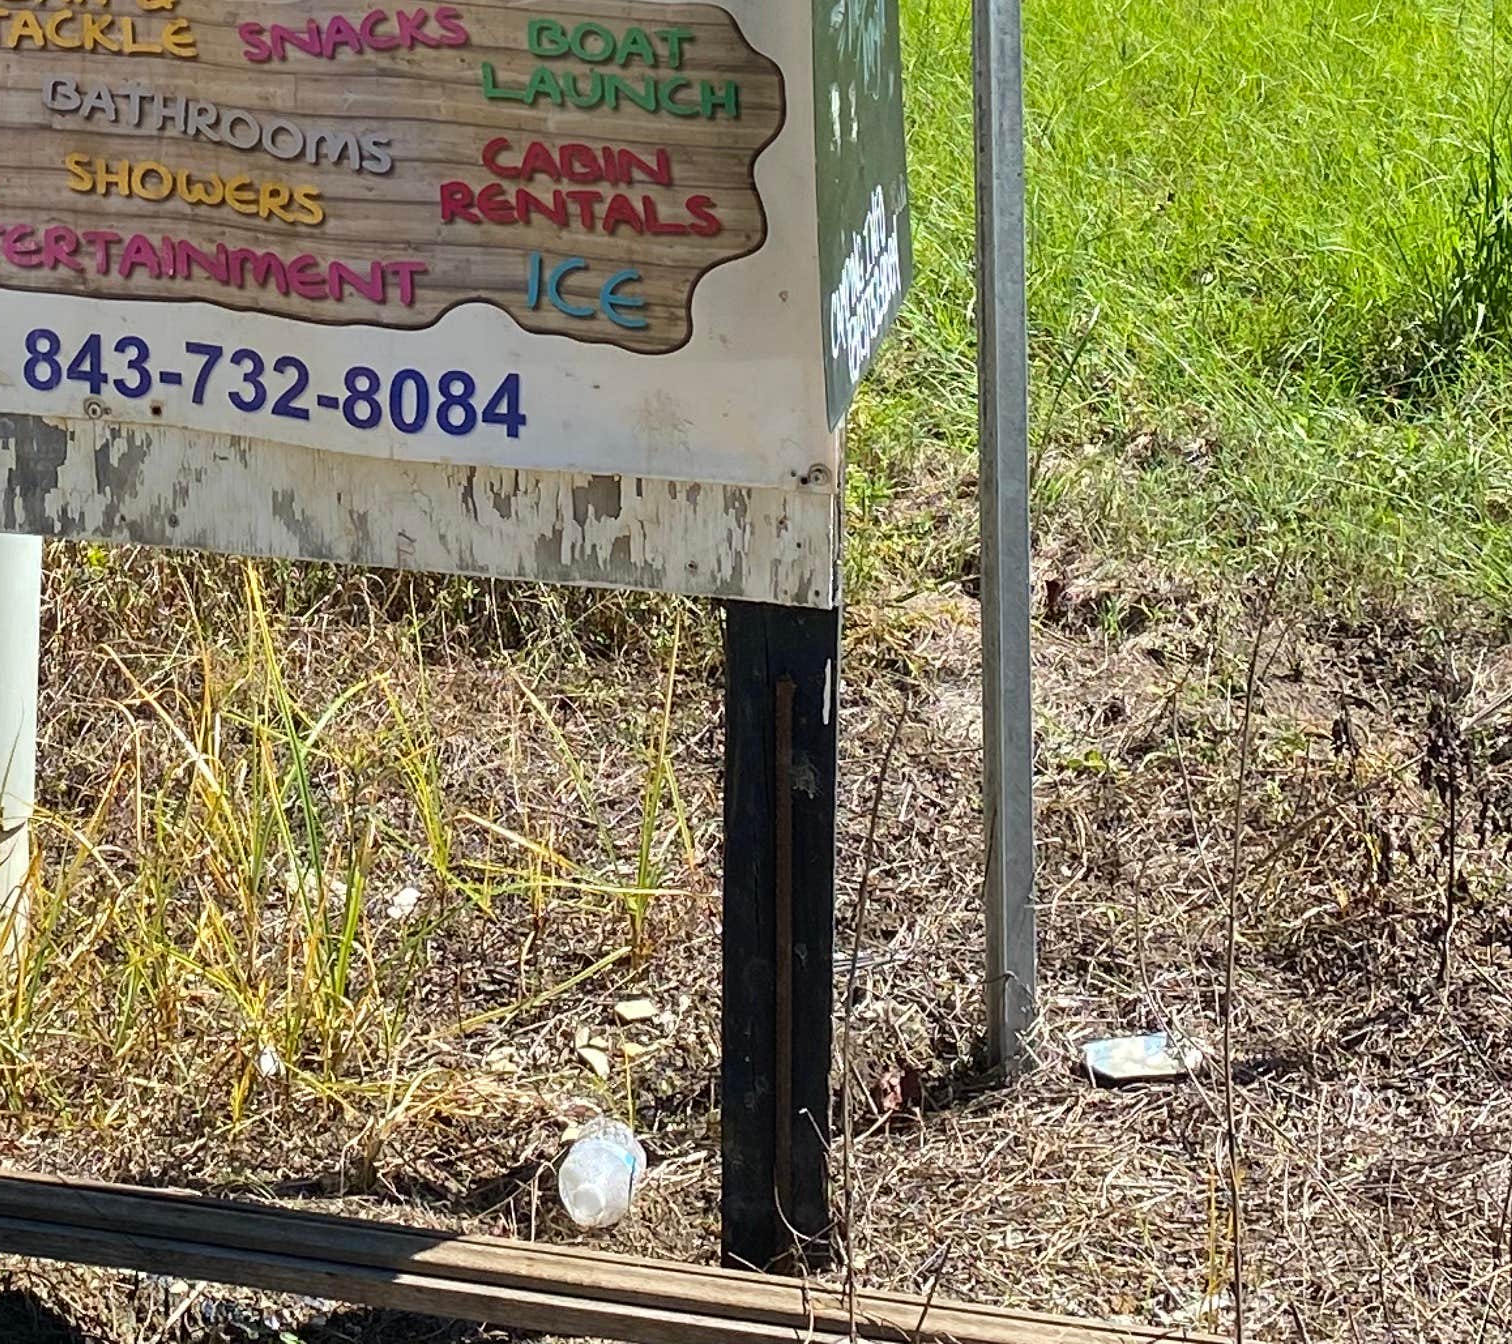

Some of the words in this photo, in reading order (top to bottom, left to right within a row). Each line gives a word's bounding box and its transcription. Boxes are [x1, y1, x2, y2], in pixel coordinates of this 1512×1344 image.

[237, 6, 469, 63] SNACKS
[527, 17, 696, 69] BOAT
[480, 60, 741, 121] LAUNCH
[42, 77, 393, 175] BATHROOMS
[65, 152, 325, 226] SHOWERS
[481, 135, 674, 187] CABIN
[439, 180, 723, 238] RENTALS
[526, 251, 648, 330] ICE
[22, 327, 527, 440] 843-732-8084
